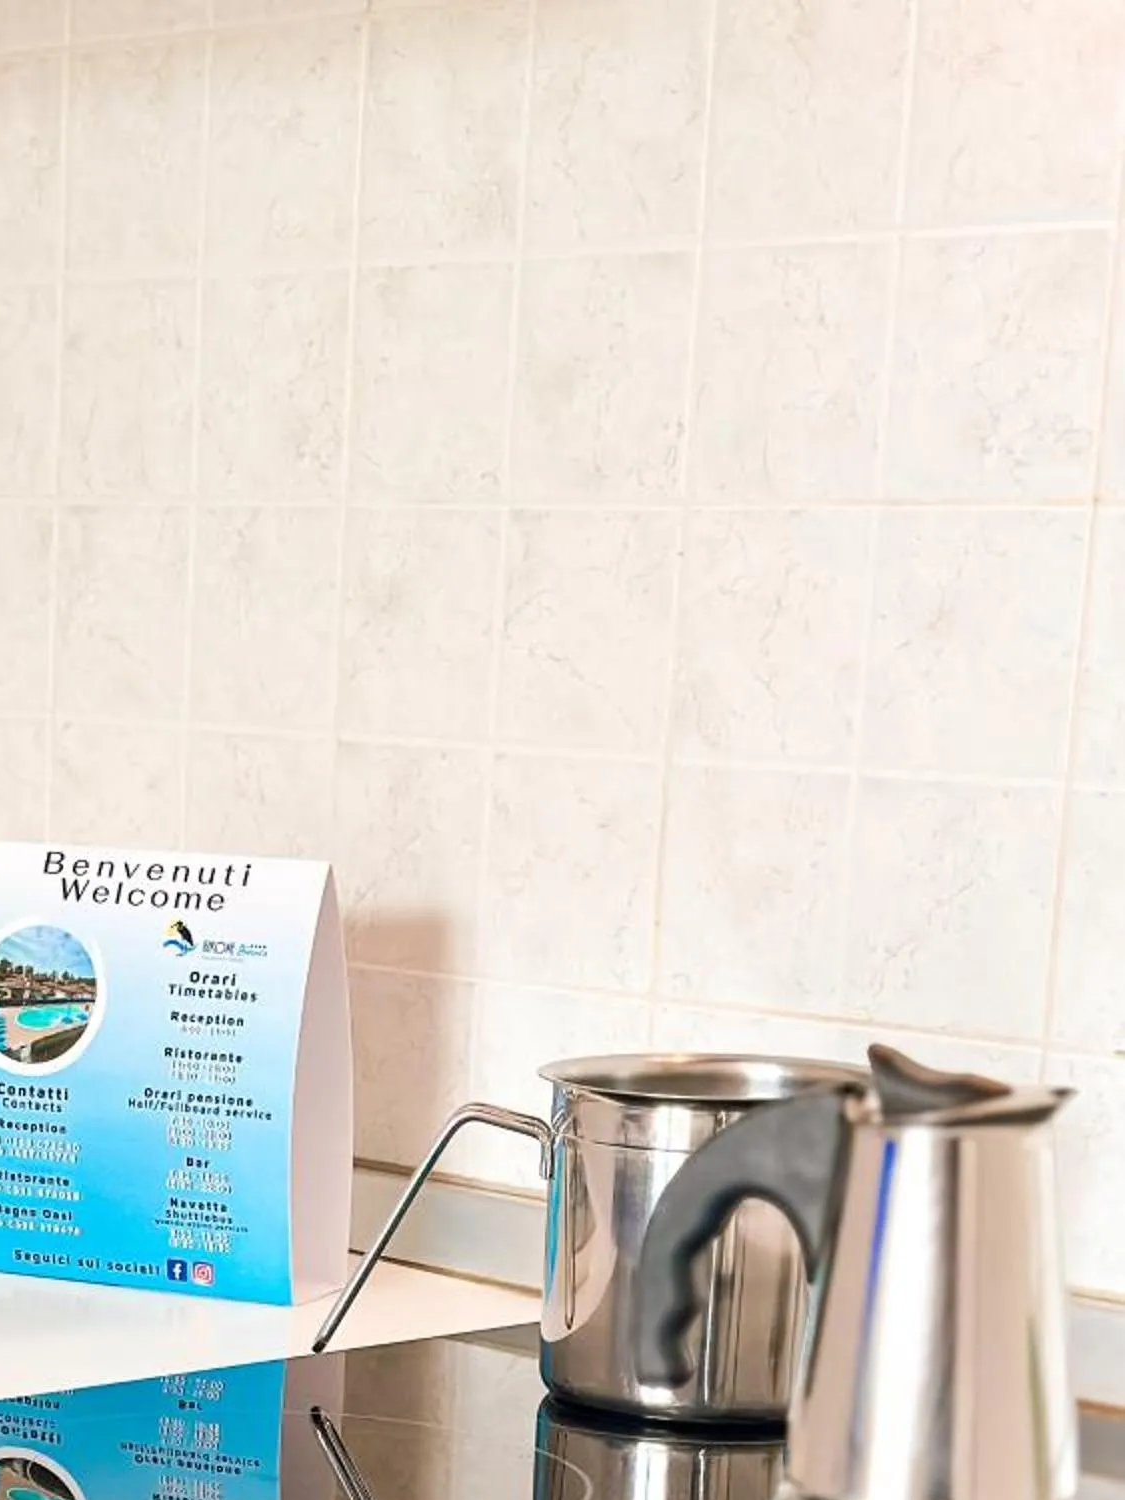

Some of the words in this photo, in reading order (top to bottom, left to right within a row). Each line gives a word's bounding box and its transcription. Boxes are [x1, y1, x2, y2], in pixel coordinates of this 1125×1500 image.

[43, 850, 252, 887] Benvenuti
[61, 877, 226, 912] Welcome
[189, 970, 237, 987] Orari
[168, 984, 258, 1003] Timetables
[170, 1011, 245, 1028] Reception
[163, 1047, 243, 1064] Ristorante
[3, 1097, 63, 1113] Contacts
[144, 1087, 182, 1101] Orari
[187, 1092, 254, 1107] pensione
[128, 1098, 220, 1116] Half/Fullboard
[225, 1108, 272, 1121] service
[186, 1156, 210, 1169] Bar
[170, 1197, 228, 1213] Navetta
[42, 1208, 73, 1222] Oasi
[165, 1209, 234, 1225] Shuttlebus
[13, 1249, 71, 1265] Seguici
[77, 1258, 100, 1270] sui
